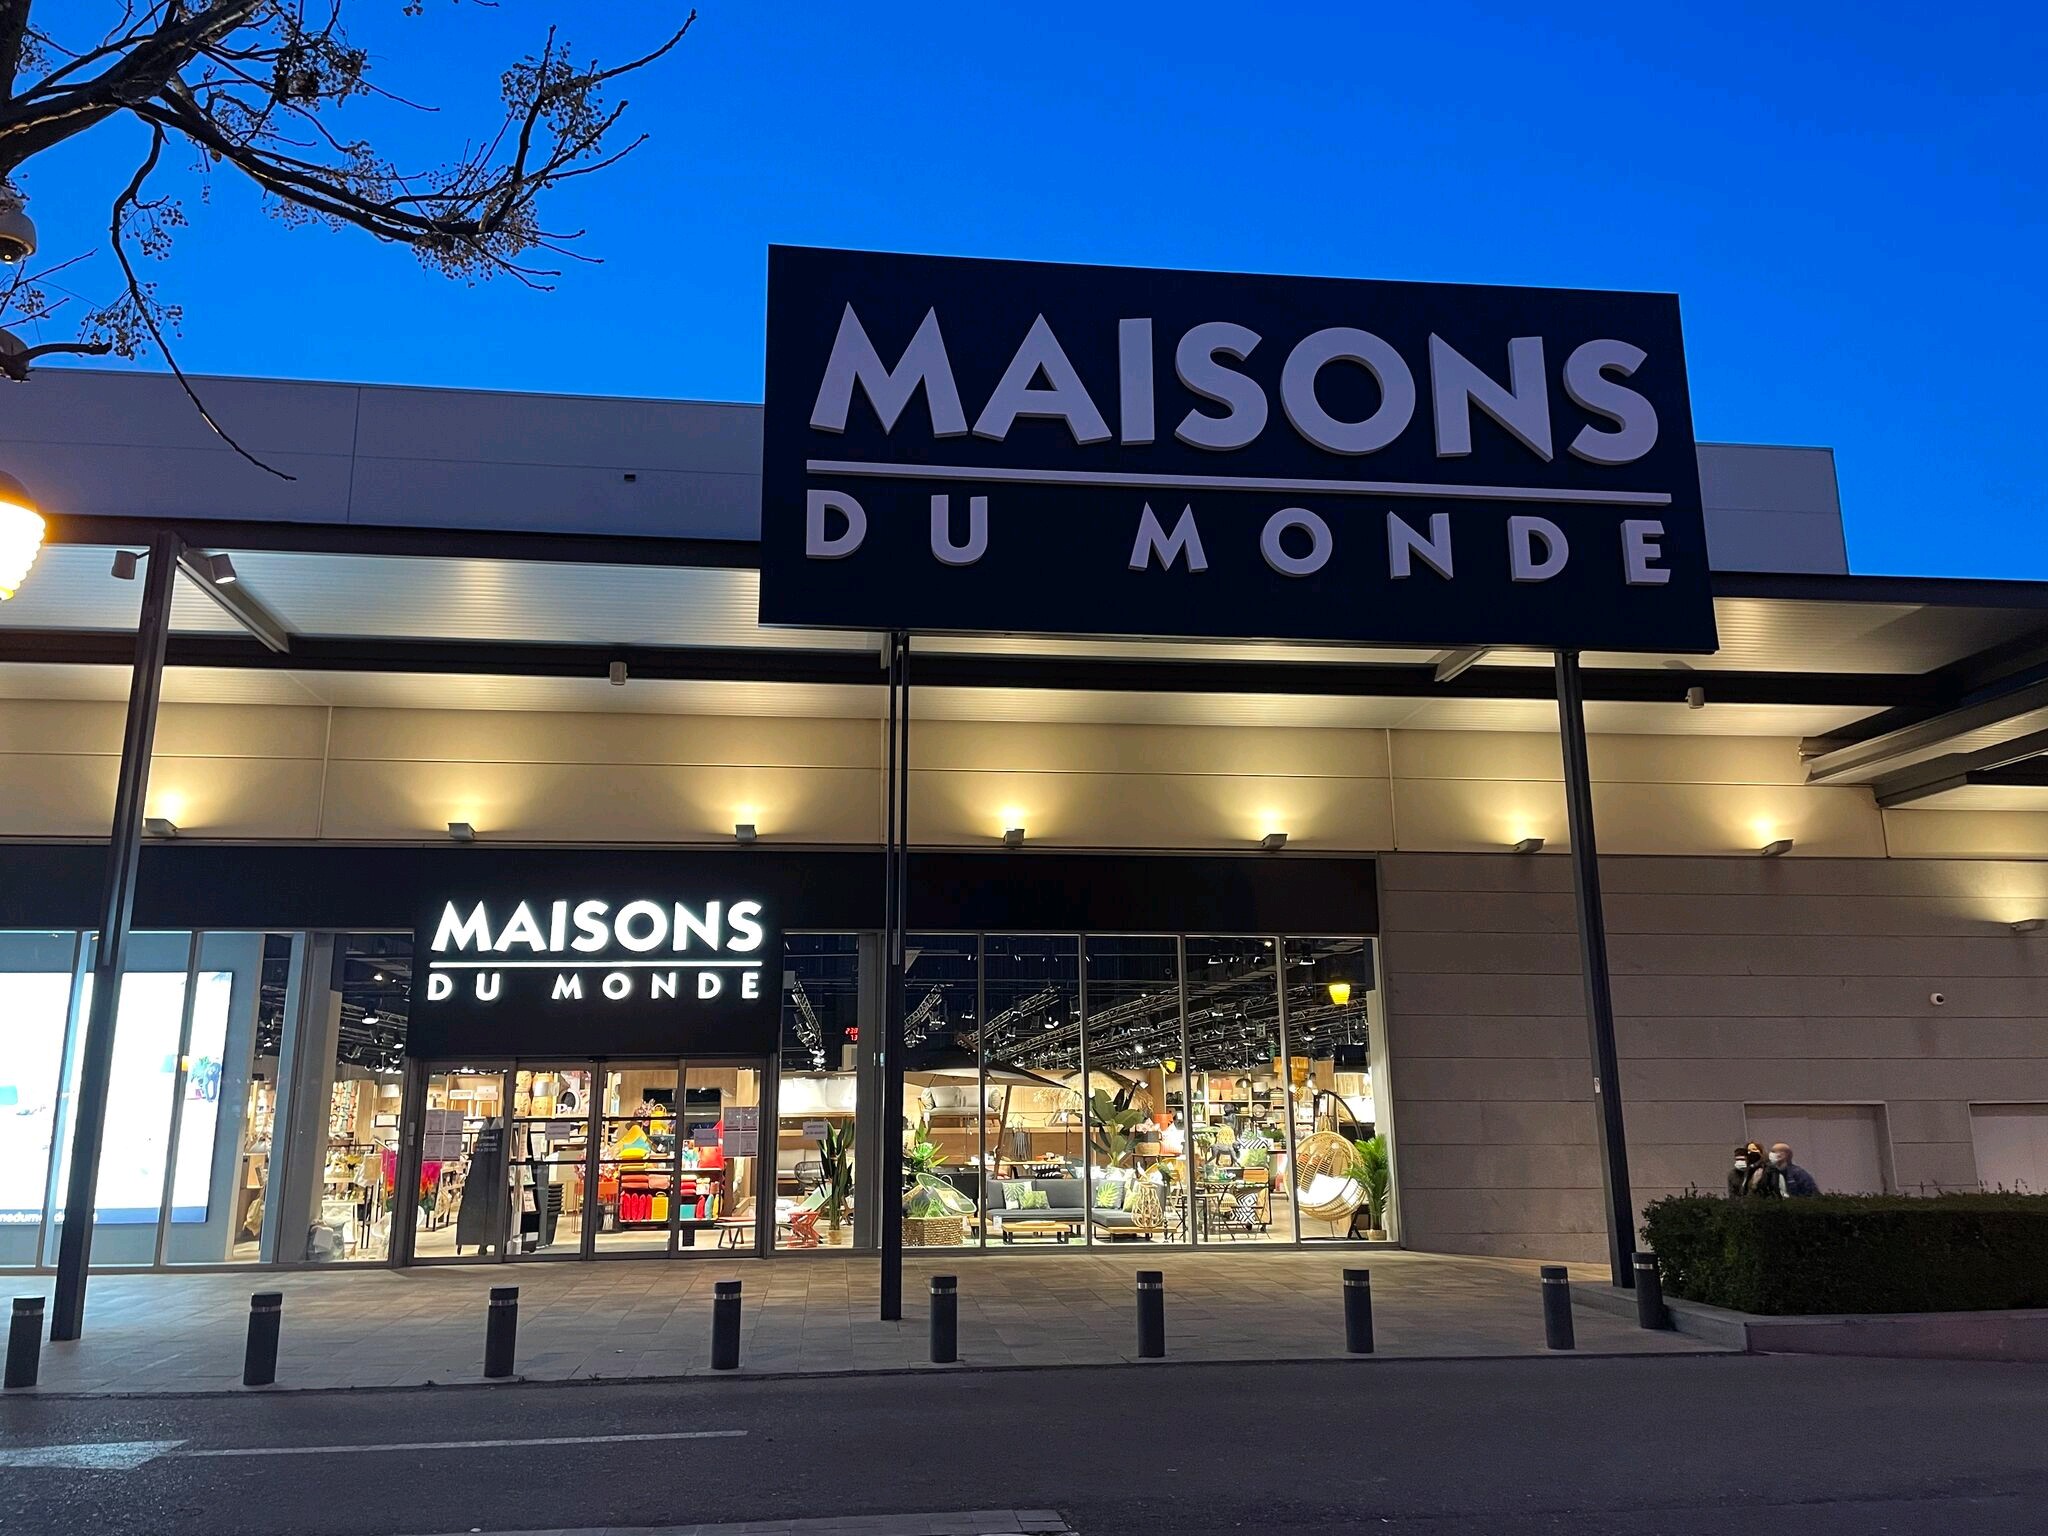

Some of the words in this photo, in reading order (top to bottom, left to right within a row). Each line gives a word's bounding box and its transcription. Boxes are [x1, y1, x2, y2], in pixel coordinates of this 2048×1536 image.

[809, 301, 1659, 465] MAISONS
[806, 489, 988, 565] DU
[1128, 501, 1672, 585] MONDE
[431, 900, 762, 952] MAISONS
[428, 973, 501, 1001] DU
[552, 972, 759, 1000] MONDE
